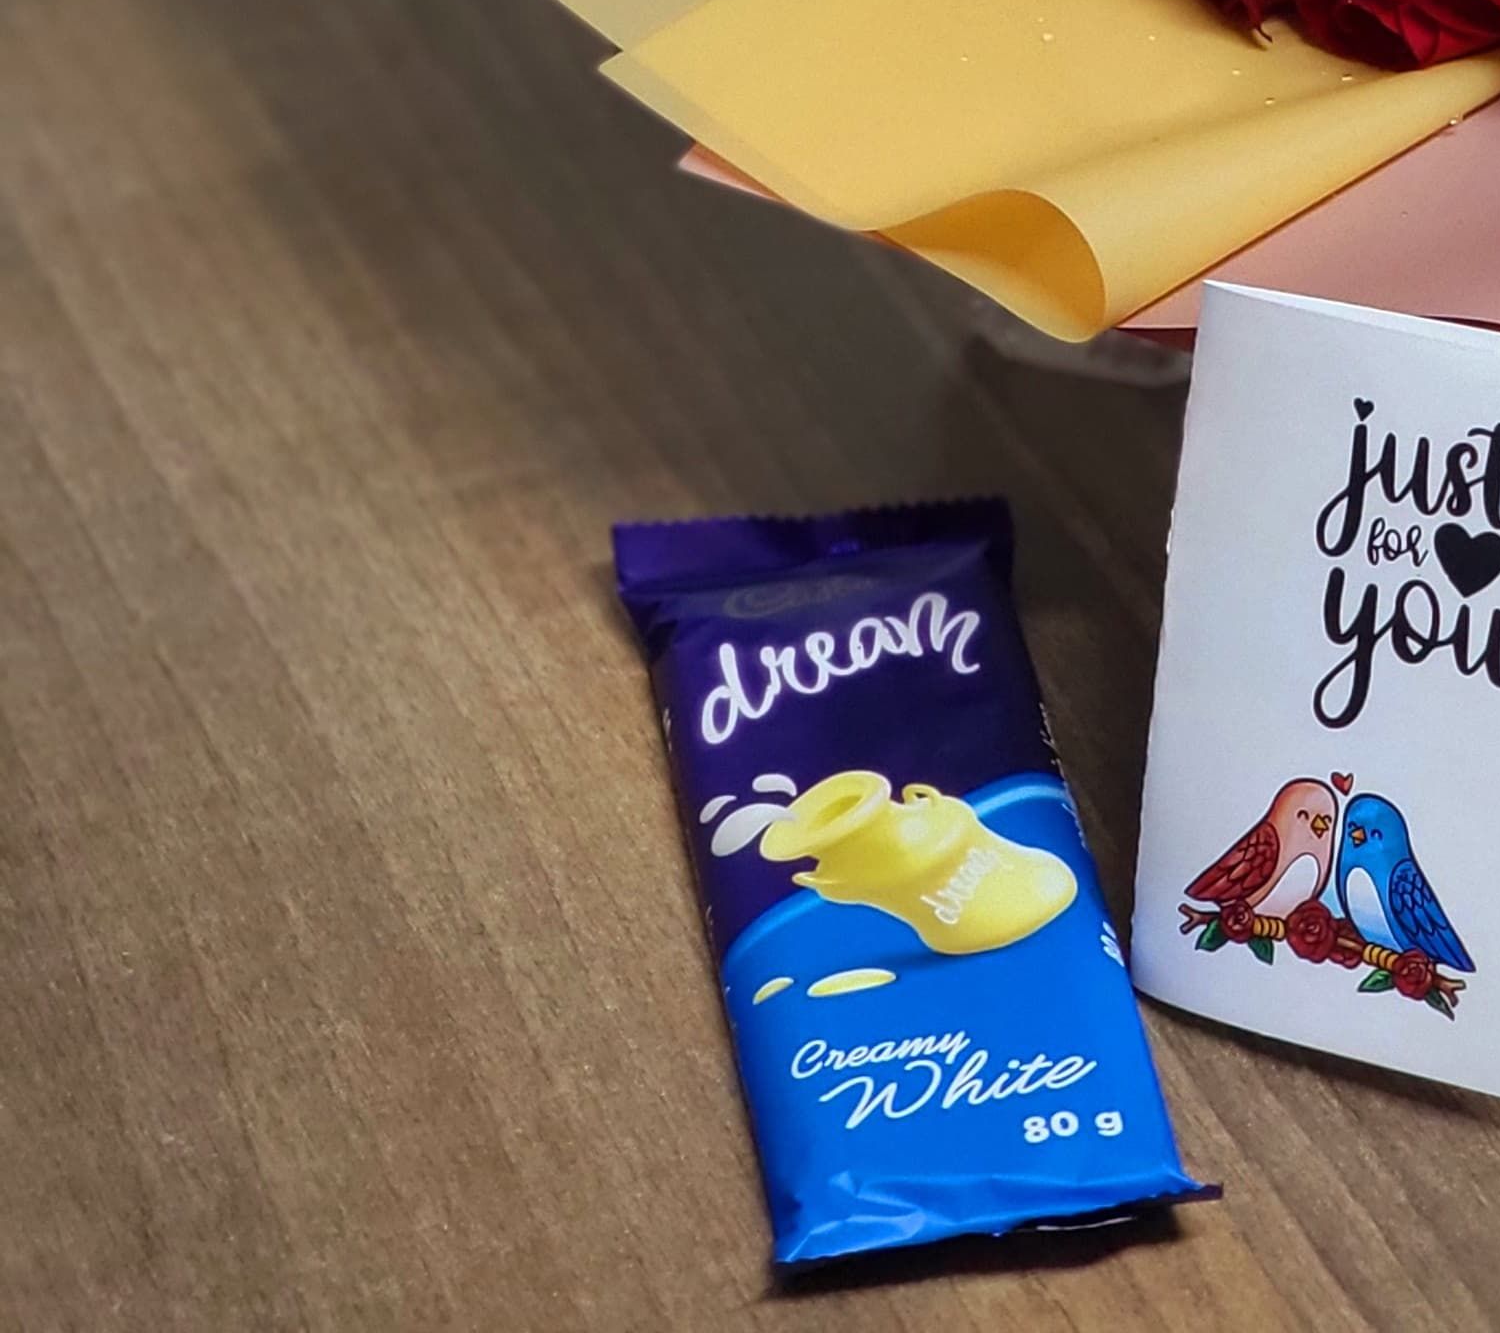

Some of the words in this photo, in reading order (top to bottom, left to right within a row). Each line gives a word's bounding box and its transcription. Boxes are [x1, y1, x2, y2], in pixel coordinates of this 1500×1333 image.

[1367, 517, 1429, 566] for
[701, 592, 980, 744] dream
[791, 1031, 970, 1079] Creamy
[818, 1049, 1097, 1129] White
[1023, 1110, 1079, 1143] 80
[1094, 1110, 1124, 1136] g
